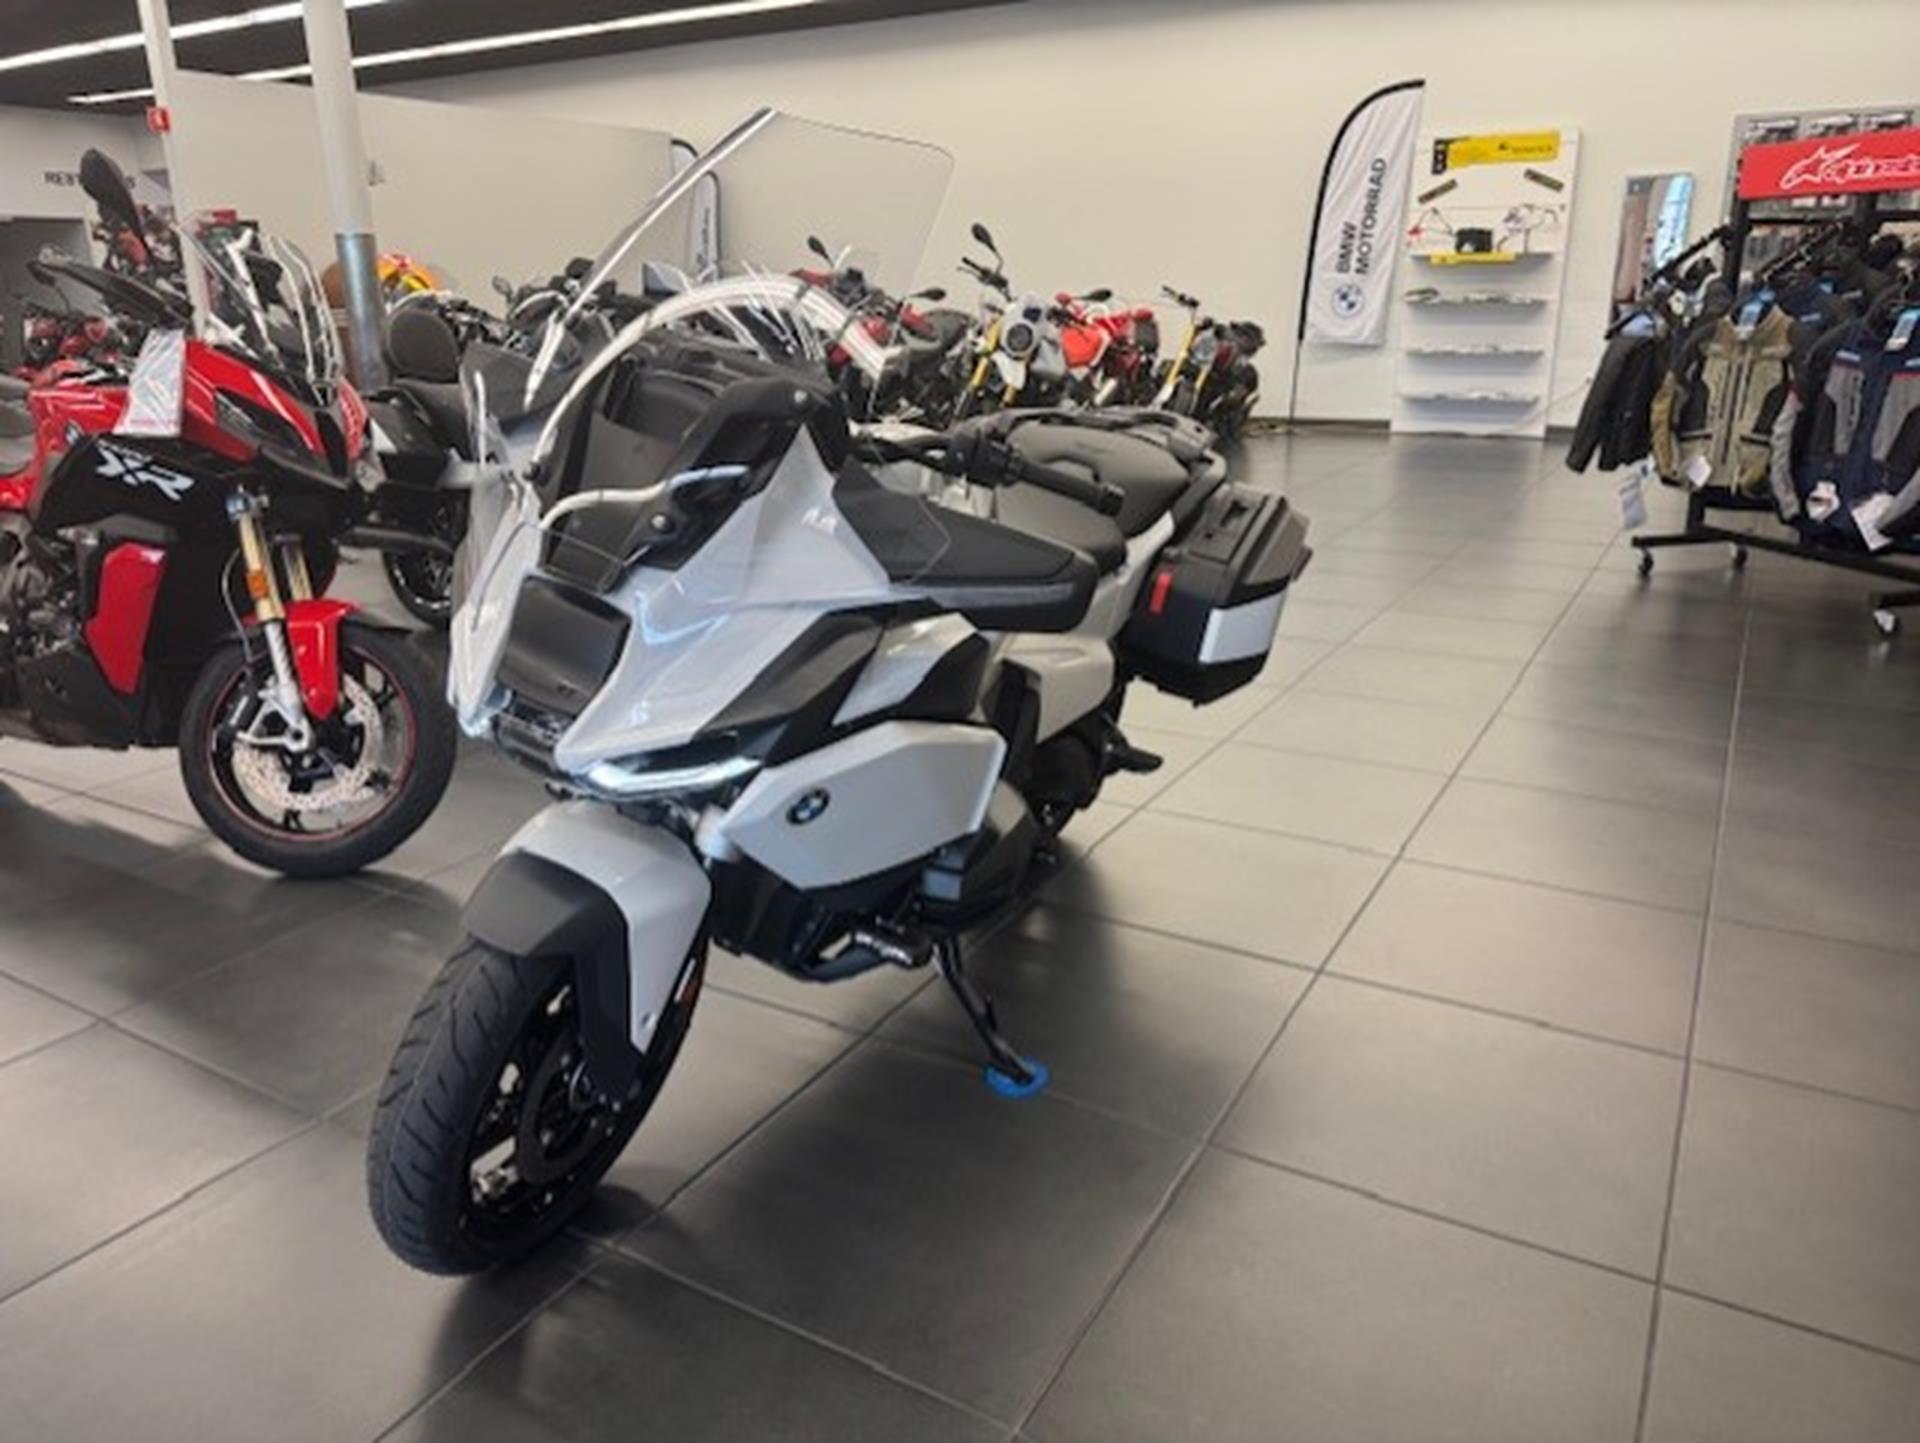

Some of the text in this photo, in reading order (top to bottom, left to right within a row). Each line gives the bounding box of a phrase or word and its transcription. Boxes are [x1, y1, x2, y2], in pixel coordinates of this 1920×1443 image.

[1354, 157, 1387, 275] MOTORRAD
[1336, 221, 1358, 274] BMW
[96, 447, 195, 501] XR
